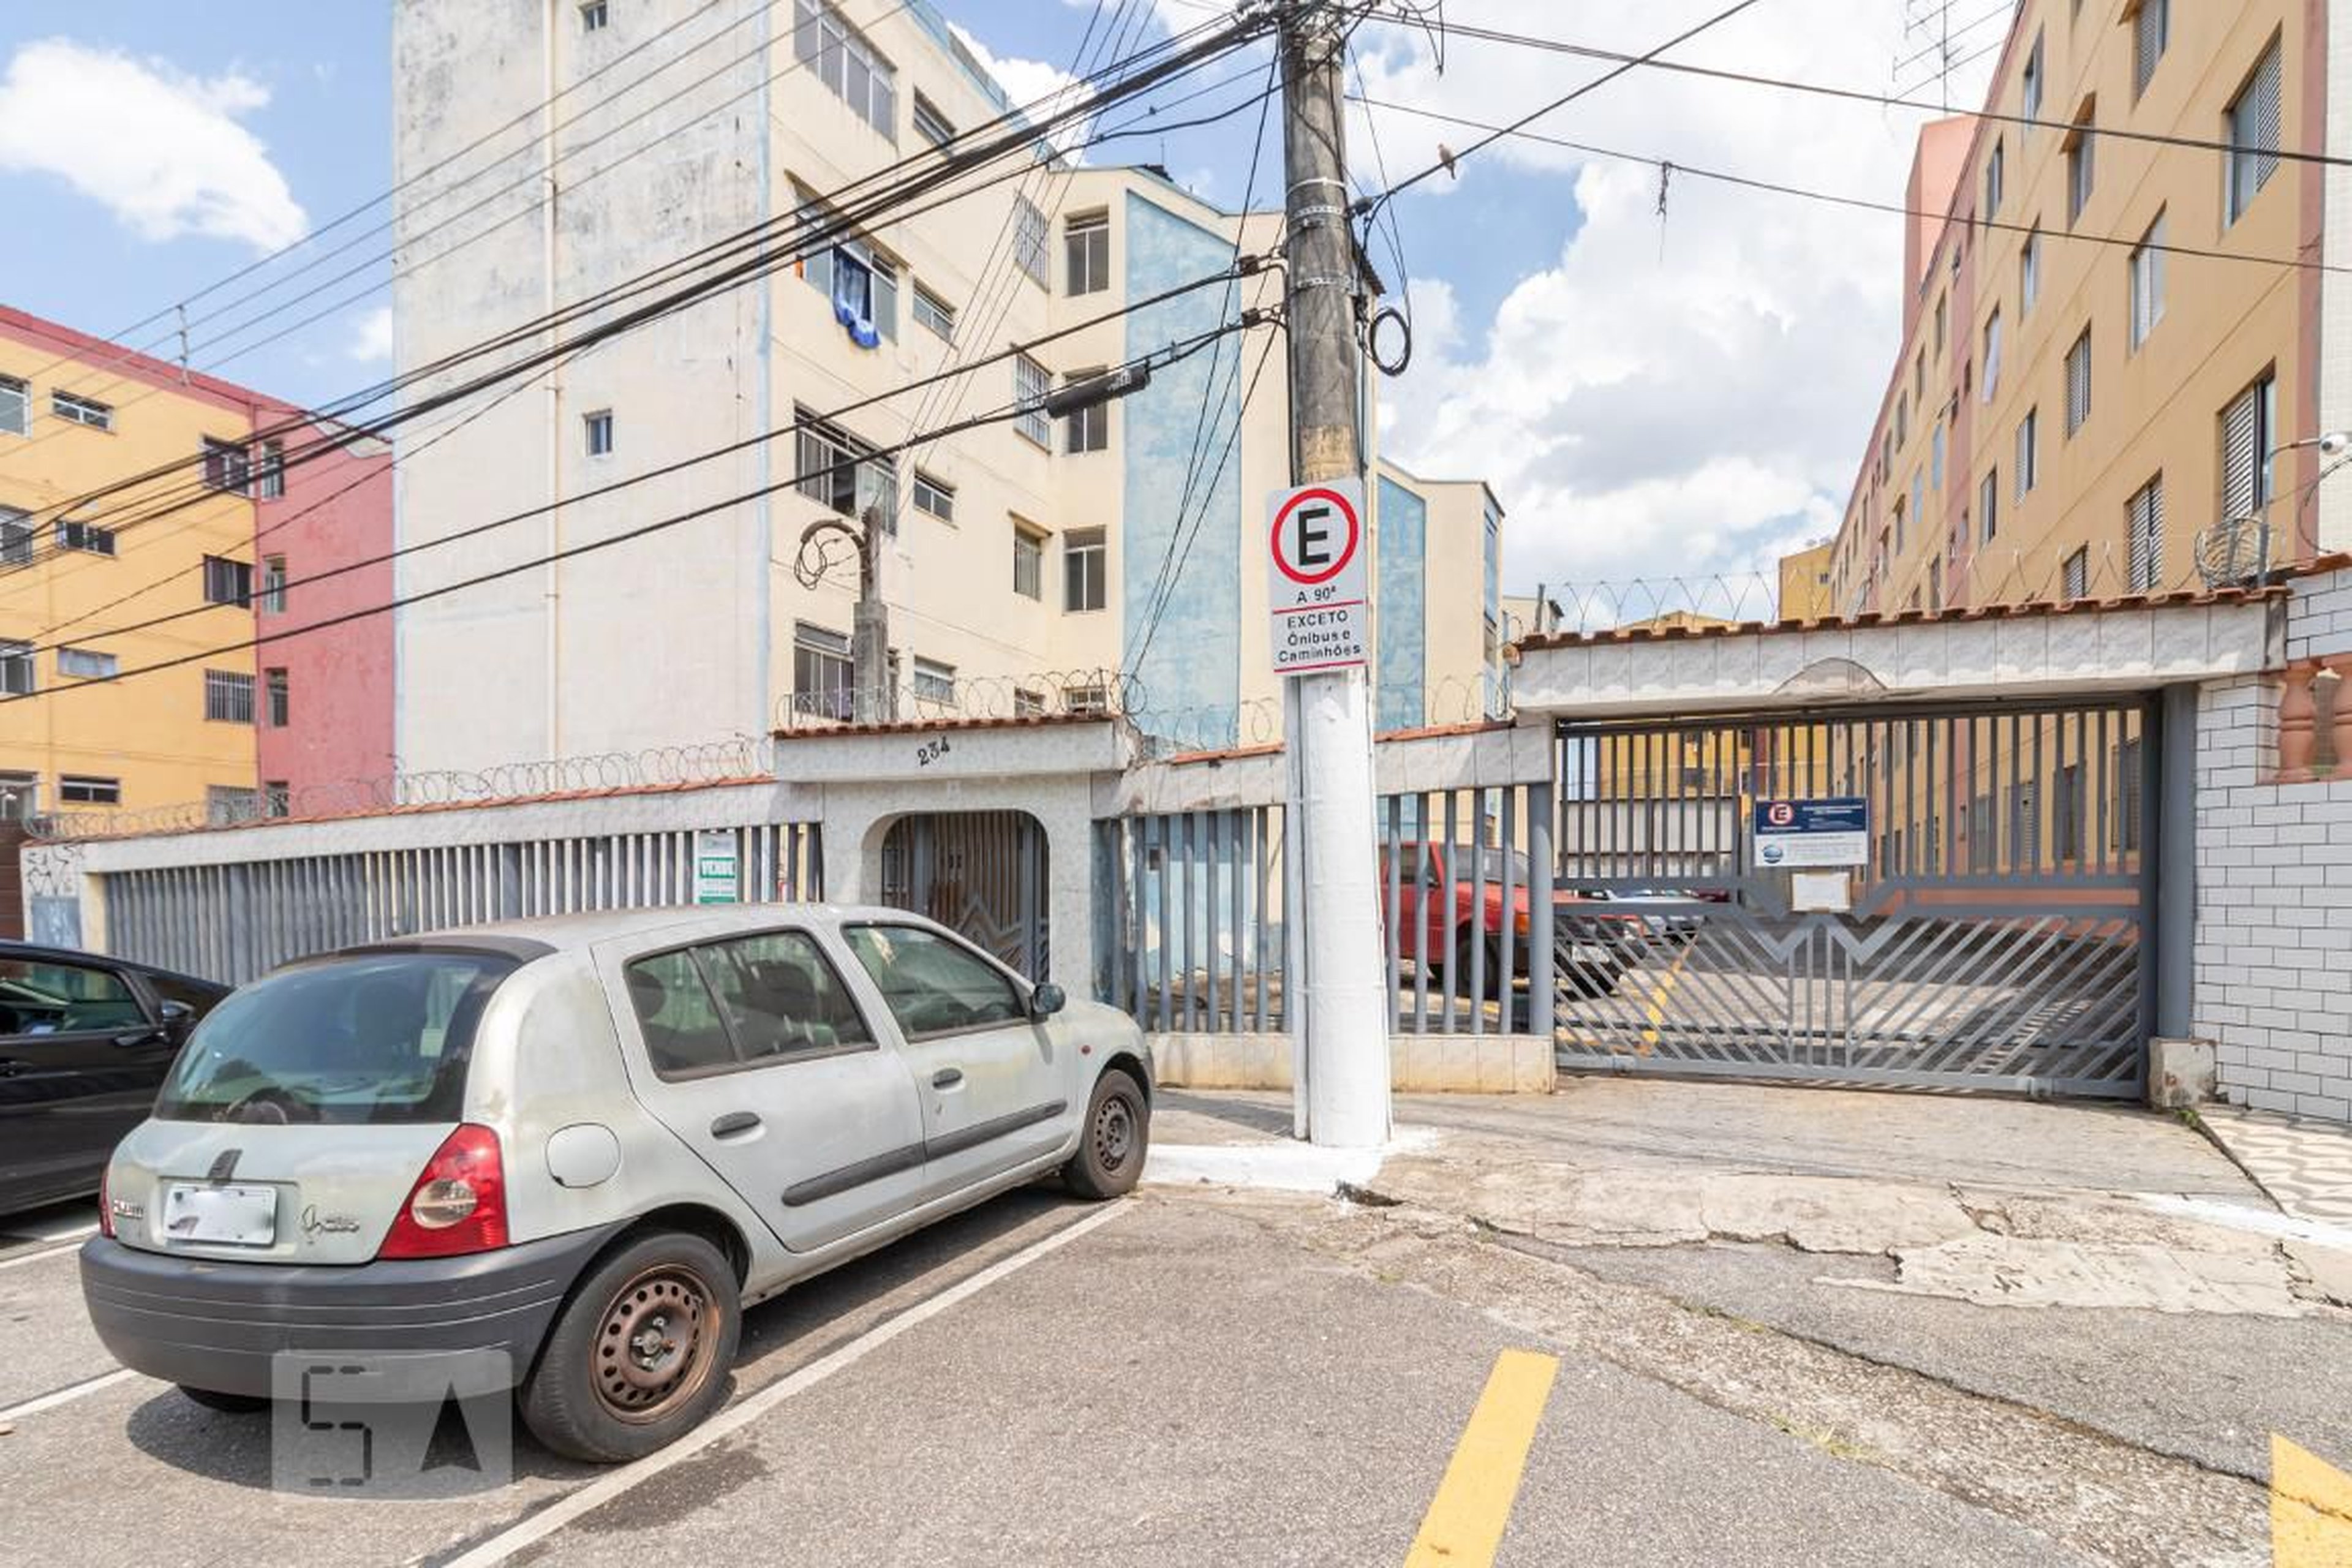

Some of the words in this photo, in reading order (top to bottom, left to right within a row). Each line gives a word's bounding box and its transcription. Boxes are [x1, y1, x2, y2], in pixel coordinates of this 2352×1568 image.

[1298, 507, 1330, 566] E
[1297, 591, 1307, 603] A
[1287, 610, 1348, 629] EXCETO
[1278, 644, 1361, 663] Caminhões
[918, 736, 950, 767] 234
